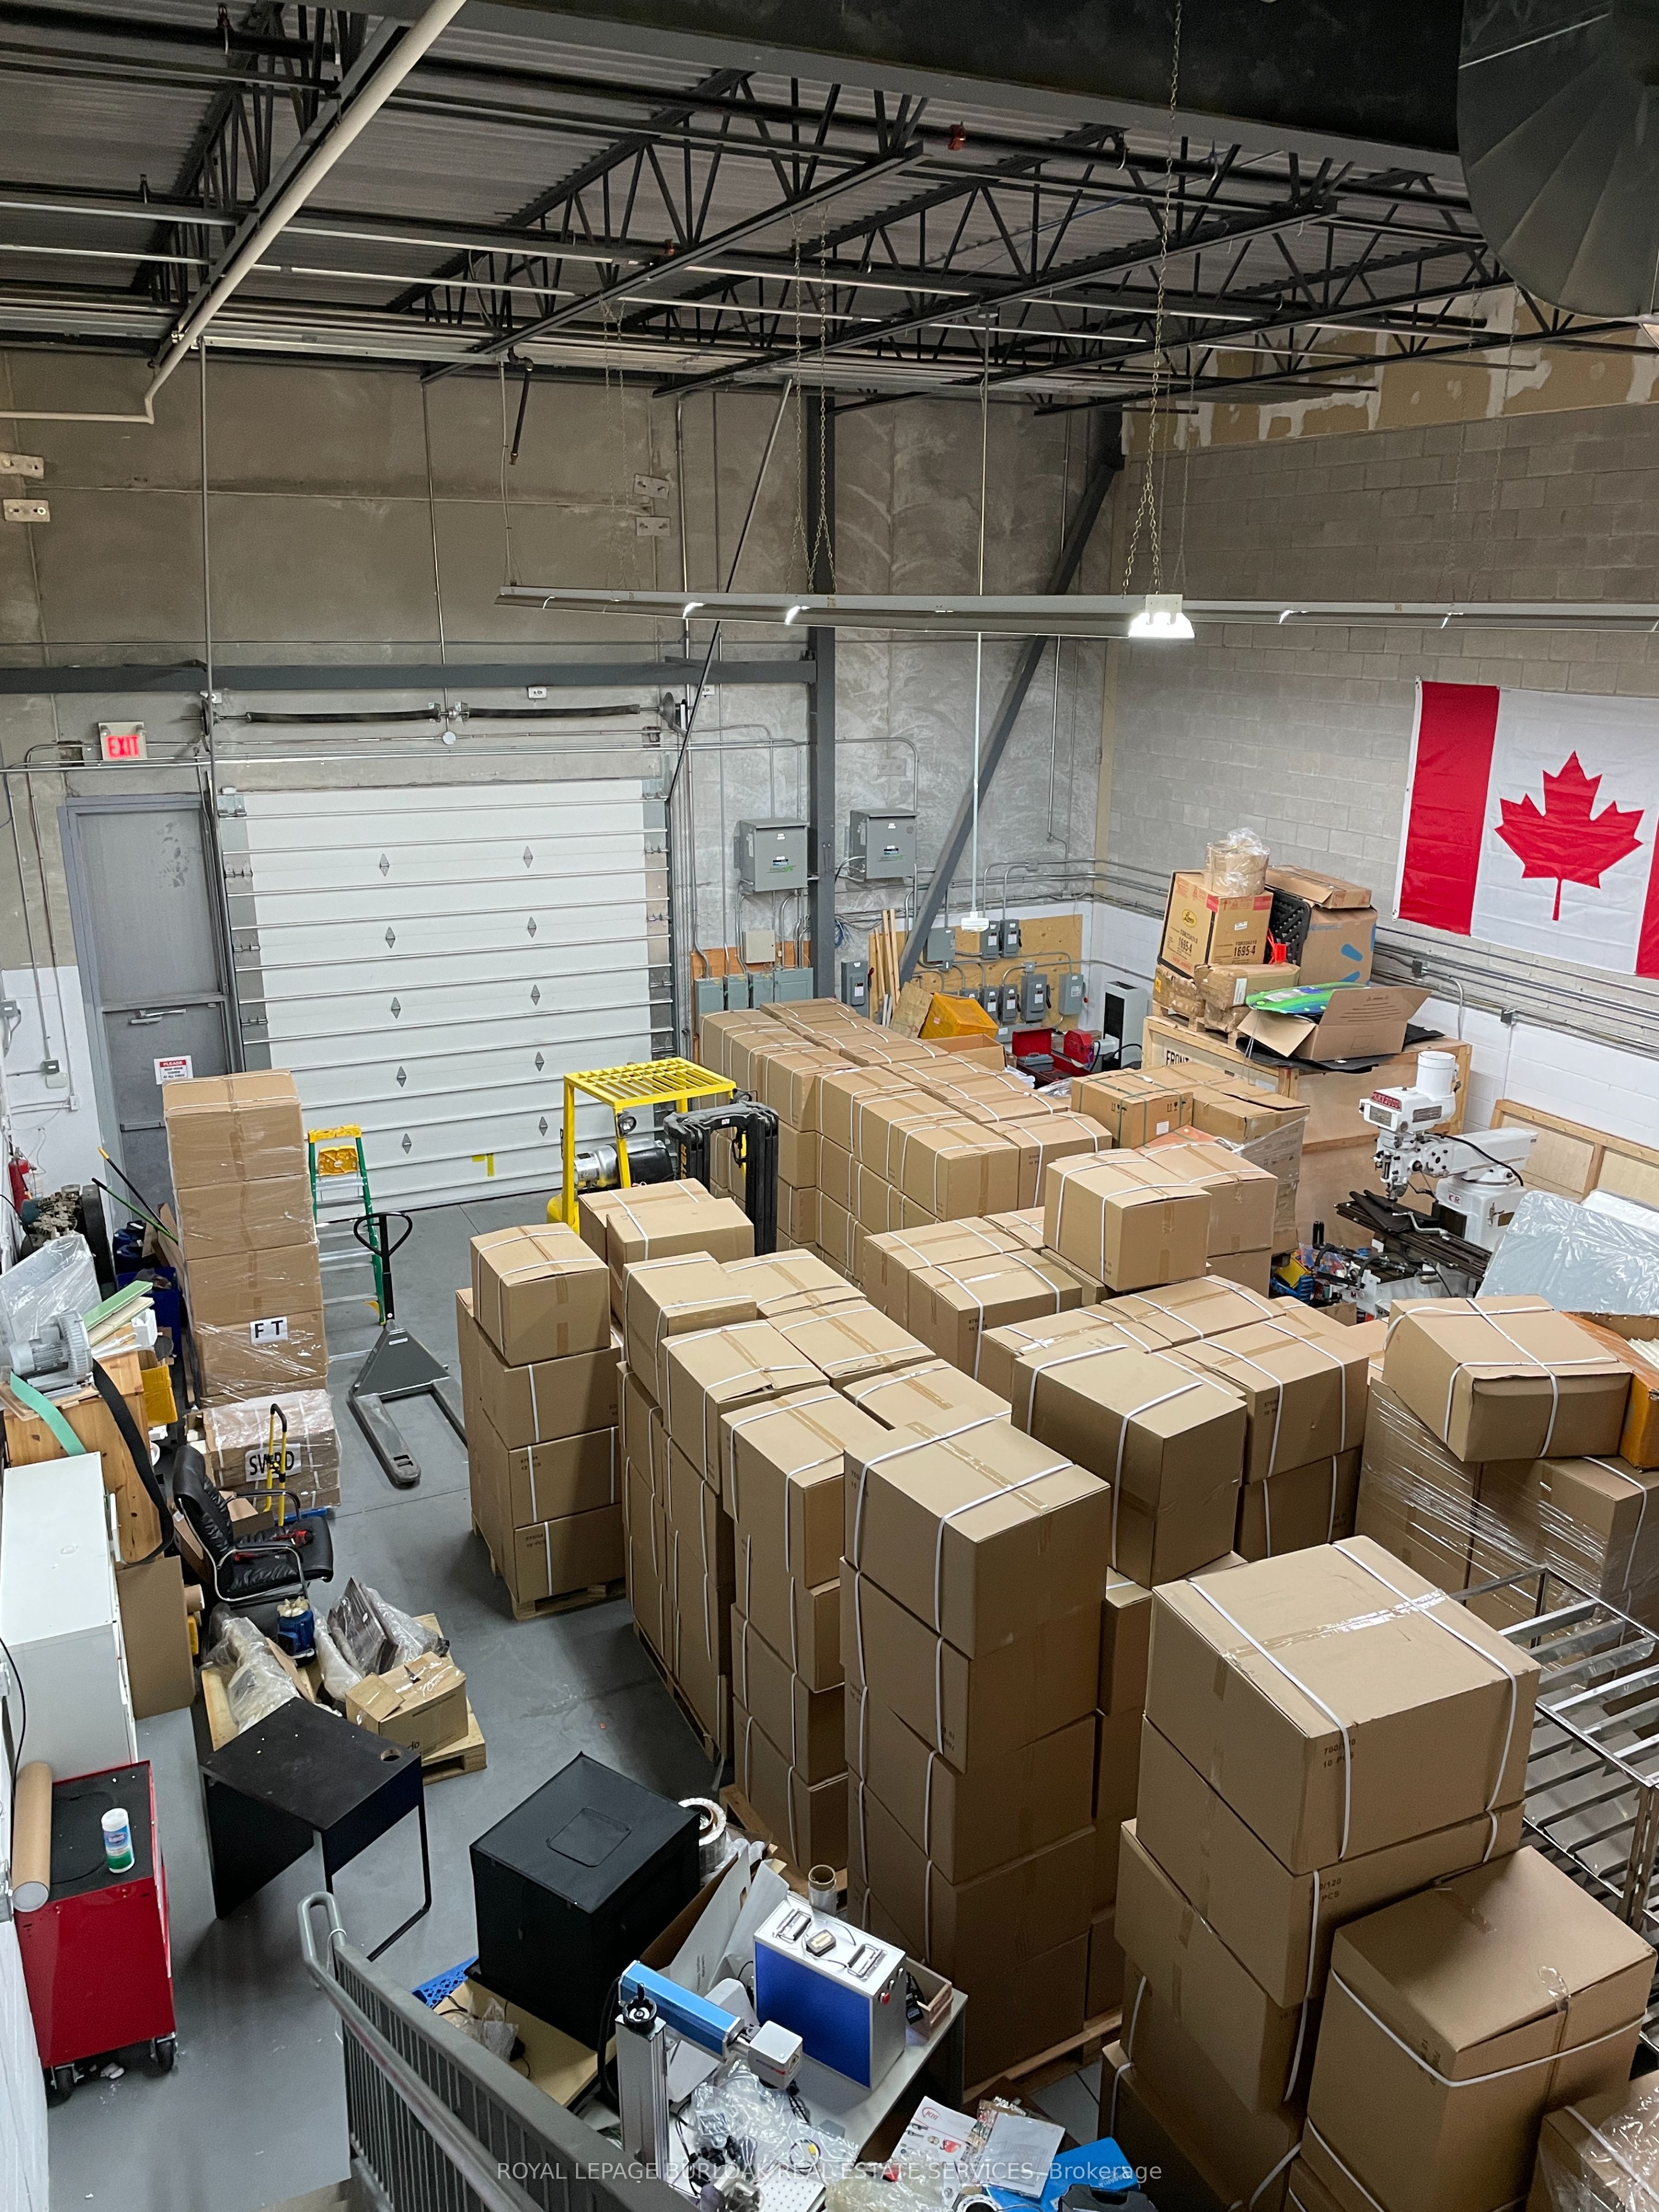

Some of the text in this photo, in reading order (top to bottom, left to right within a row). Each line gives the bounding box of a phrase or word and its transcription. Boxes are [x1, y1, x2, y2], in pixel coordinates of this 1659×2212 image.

[107, 736, 139, 757] EXIT
[1234, 945, 1256, 957] 1695-4
[255, 1320, 283, 1338] F T
[1324, 1760, 1332, 1768] 10
[1322, 1891, 1339, 1902] PCS
